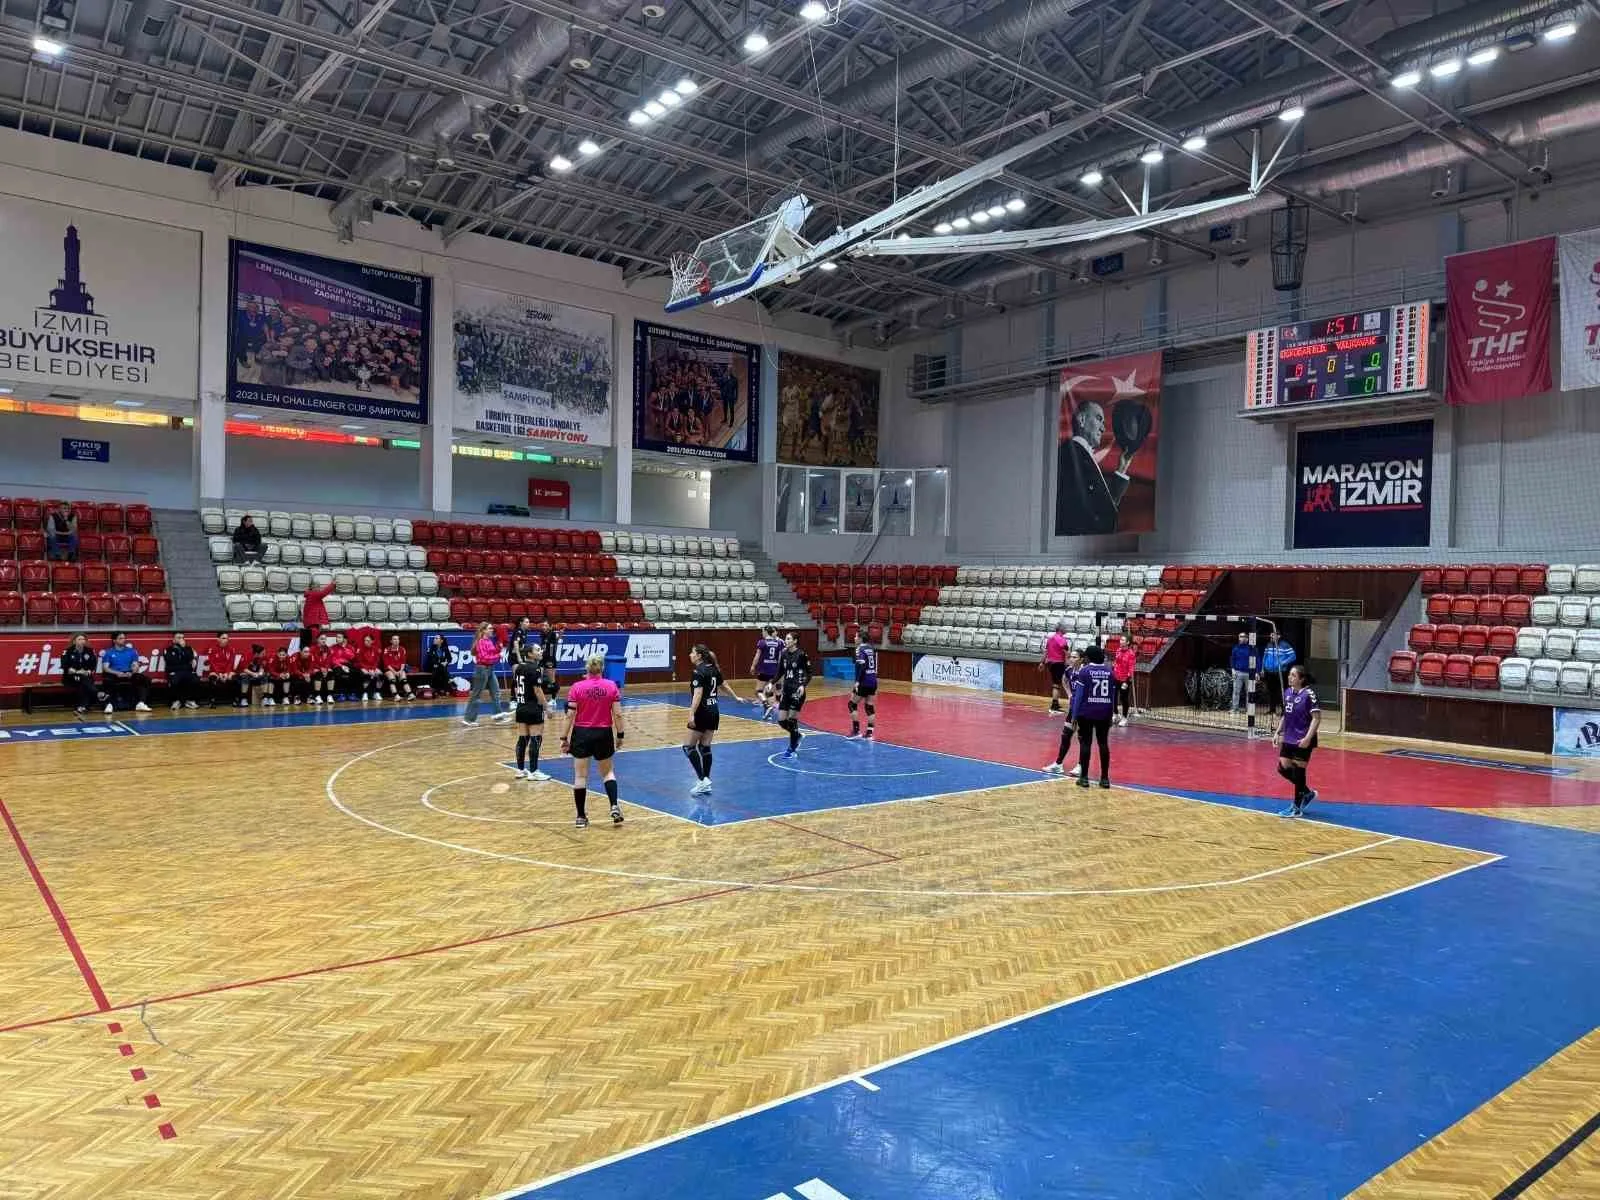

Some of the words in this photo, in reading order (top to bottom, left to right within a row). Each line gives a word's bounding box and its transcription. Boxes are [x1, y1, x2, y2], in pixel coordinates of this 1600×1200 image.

[0, 326, 155, 364] BÜYÜKŞEHİR
[1467, 330, 1528, 358] THF
[1371, 352, 1380, 367] 0
[1295, 363, 1304, 377] 0
[1364, 376, 1375, 393] 0
[236, 390, 258, 400] 2023
[260, 393, 280, 402] LEN
[282, 395, 346, 410] CHALLENGER
[347, 403, 366, 412] CUP
[1303, 458, 1423, 484] MARATON
[515, 675, 525, 695] 15
[710, 676, 717, 696] 2
[1092, 679, 1109, 697] 78
